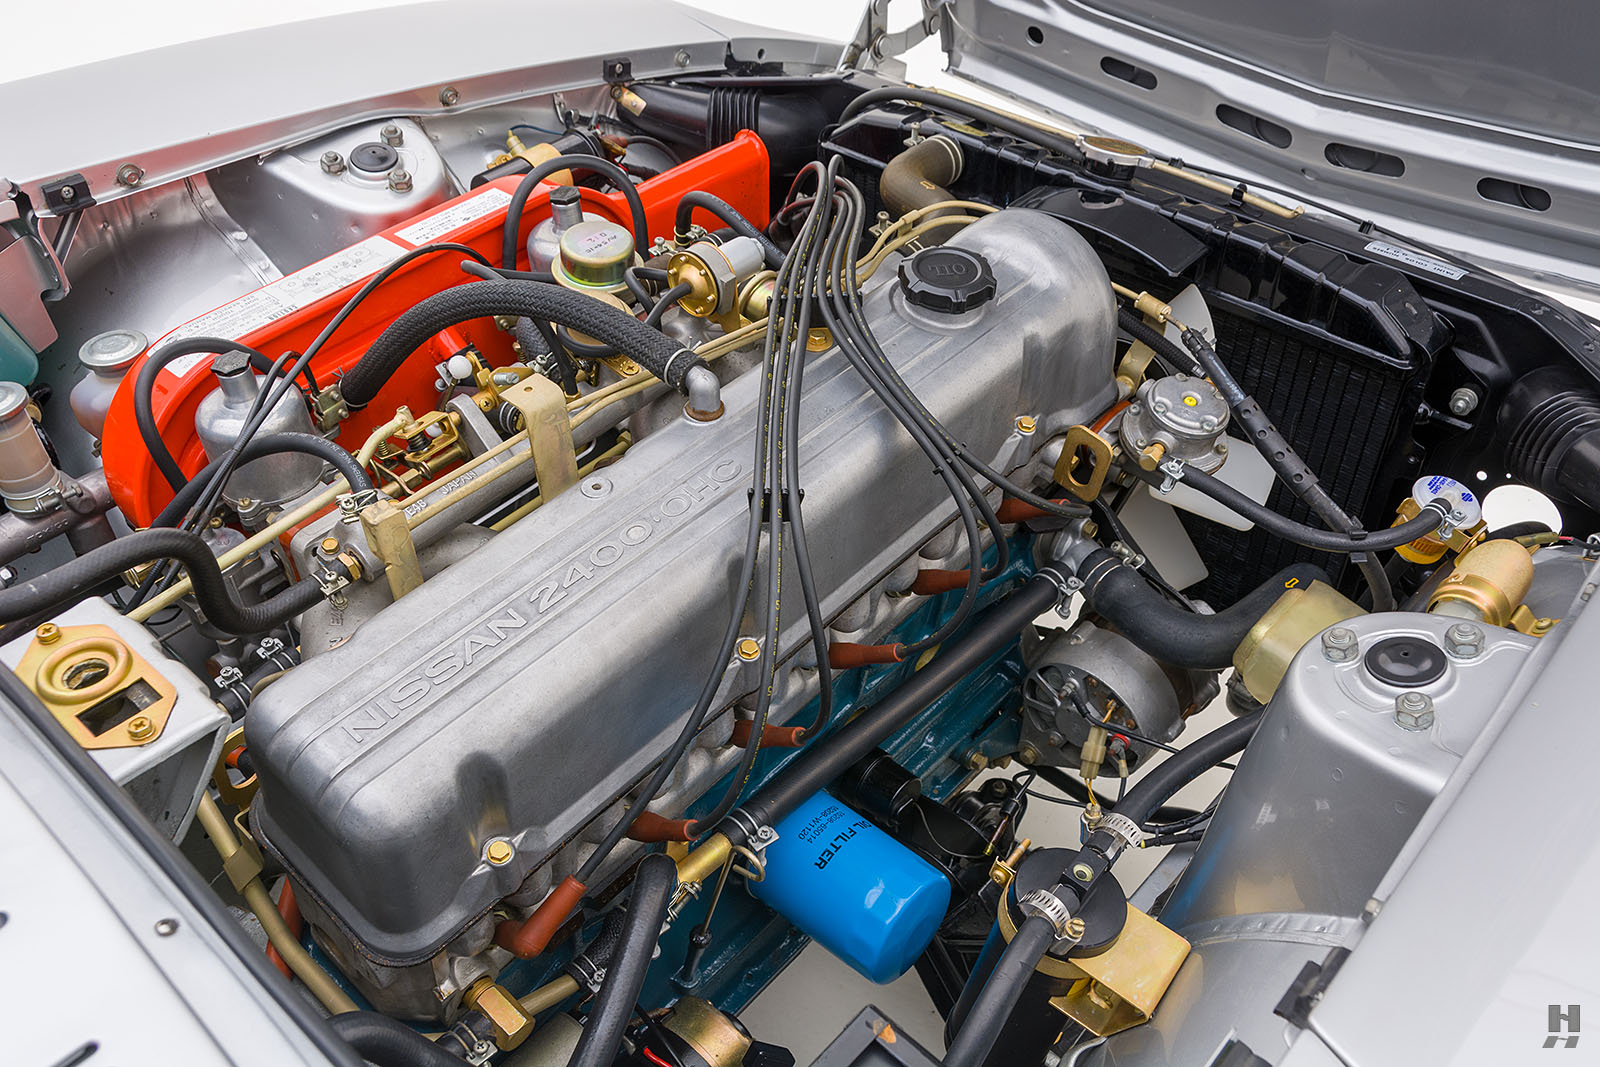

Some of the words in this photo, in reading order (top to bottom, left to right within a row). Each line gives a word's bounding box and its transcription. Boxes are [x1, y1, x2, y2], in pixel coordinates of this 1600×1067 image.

[928, 263, 966, 276] OIL
[442, 470, 478, 495] JAPAN
[342, 605, 527, 743] NISSAN
[798, 805, 839, 840] 15208-W1120
[807, 811, 845, 844] 15208-65014
[853, 820, 872, 830] OIL
[814, 827, 857, 870] FILTER
